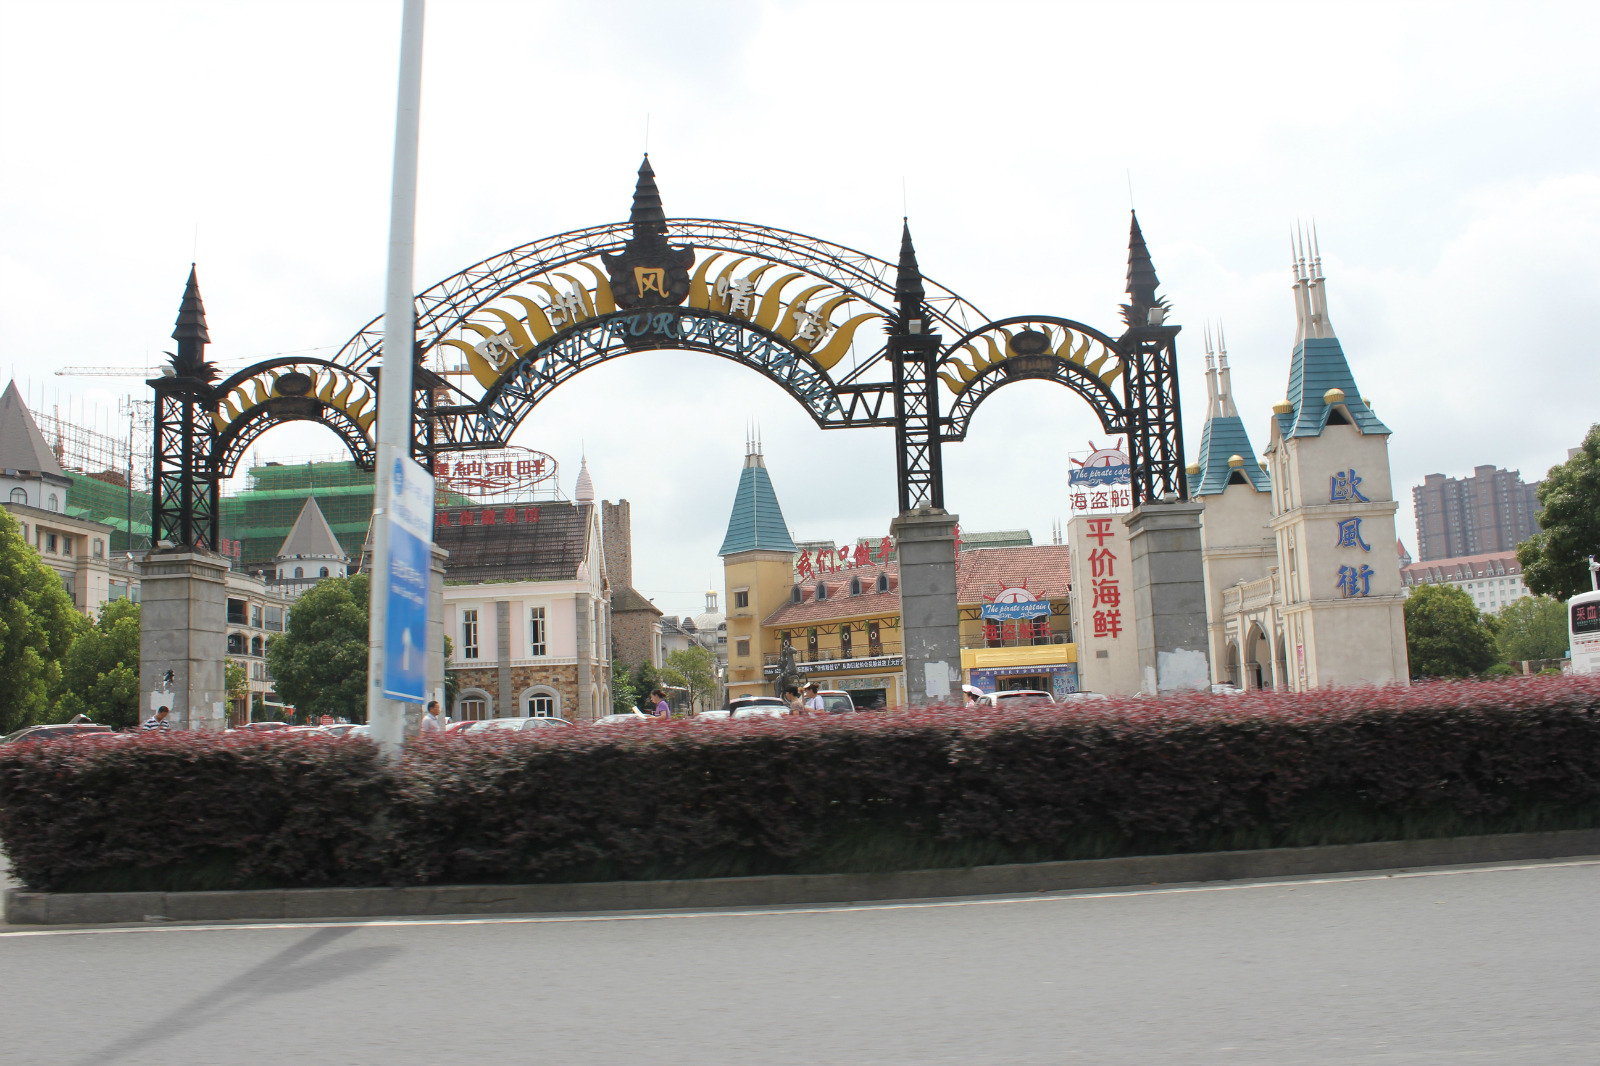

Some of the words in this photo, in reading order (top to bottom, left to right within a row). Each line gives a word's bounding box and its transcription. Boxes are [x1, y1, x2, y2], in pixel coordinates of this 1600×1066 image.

[606, 312, 743, 346] EUROPE
[740, 332, 850, 421] STREET
[1073, 469, 1088, 479] The
[1089, 469, 1113, 479] pirate
[1086, 518, 1122, 638] 平价海鲜
[985, 604, 999, 613] The
[999, 605, 1020, 614] pirate
[1021, 603, 1047, 613] captain
[1576, 605, 1600, 621] 采血
[982, 621, 1054, 640] 海盗船长
